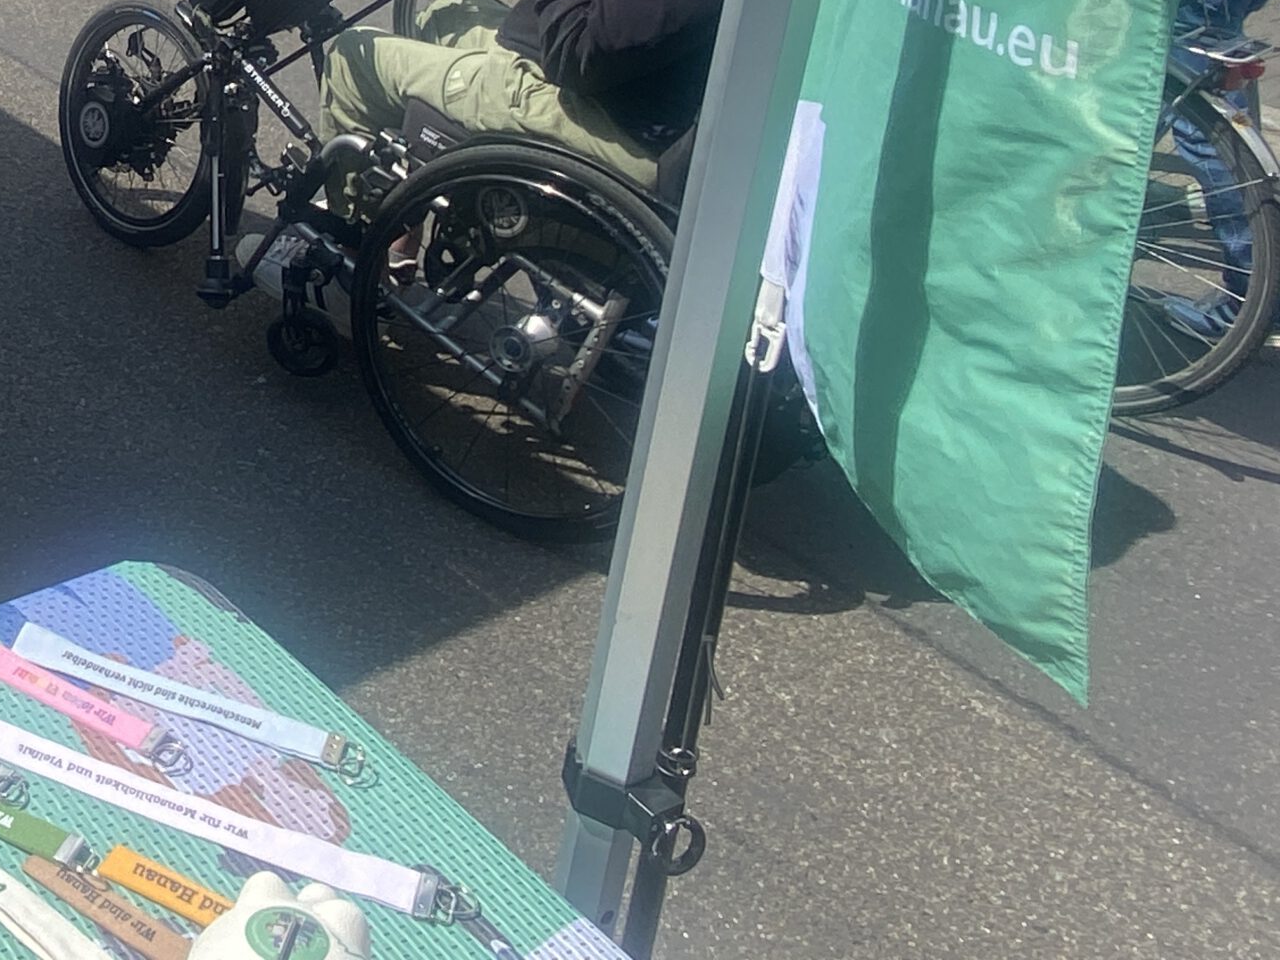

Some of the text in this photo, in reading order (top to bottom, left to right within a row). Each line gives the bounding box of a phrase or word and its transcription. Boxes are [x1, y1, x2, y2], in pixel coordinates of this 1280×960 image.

[243, 63, 285, 108] STRICKER
[61, 650, 262, 730] Menschenrechte sind nicht verhandelbar
[17, 743, 249, 840] Wir für Menschlichkeit und Vielfalt
[55, 867, 157, 943] Wir sind Hanau
[132, 862, 199, 906] Hanau
